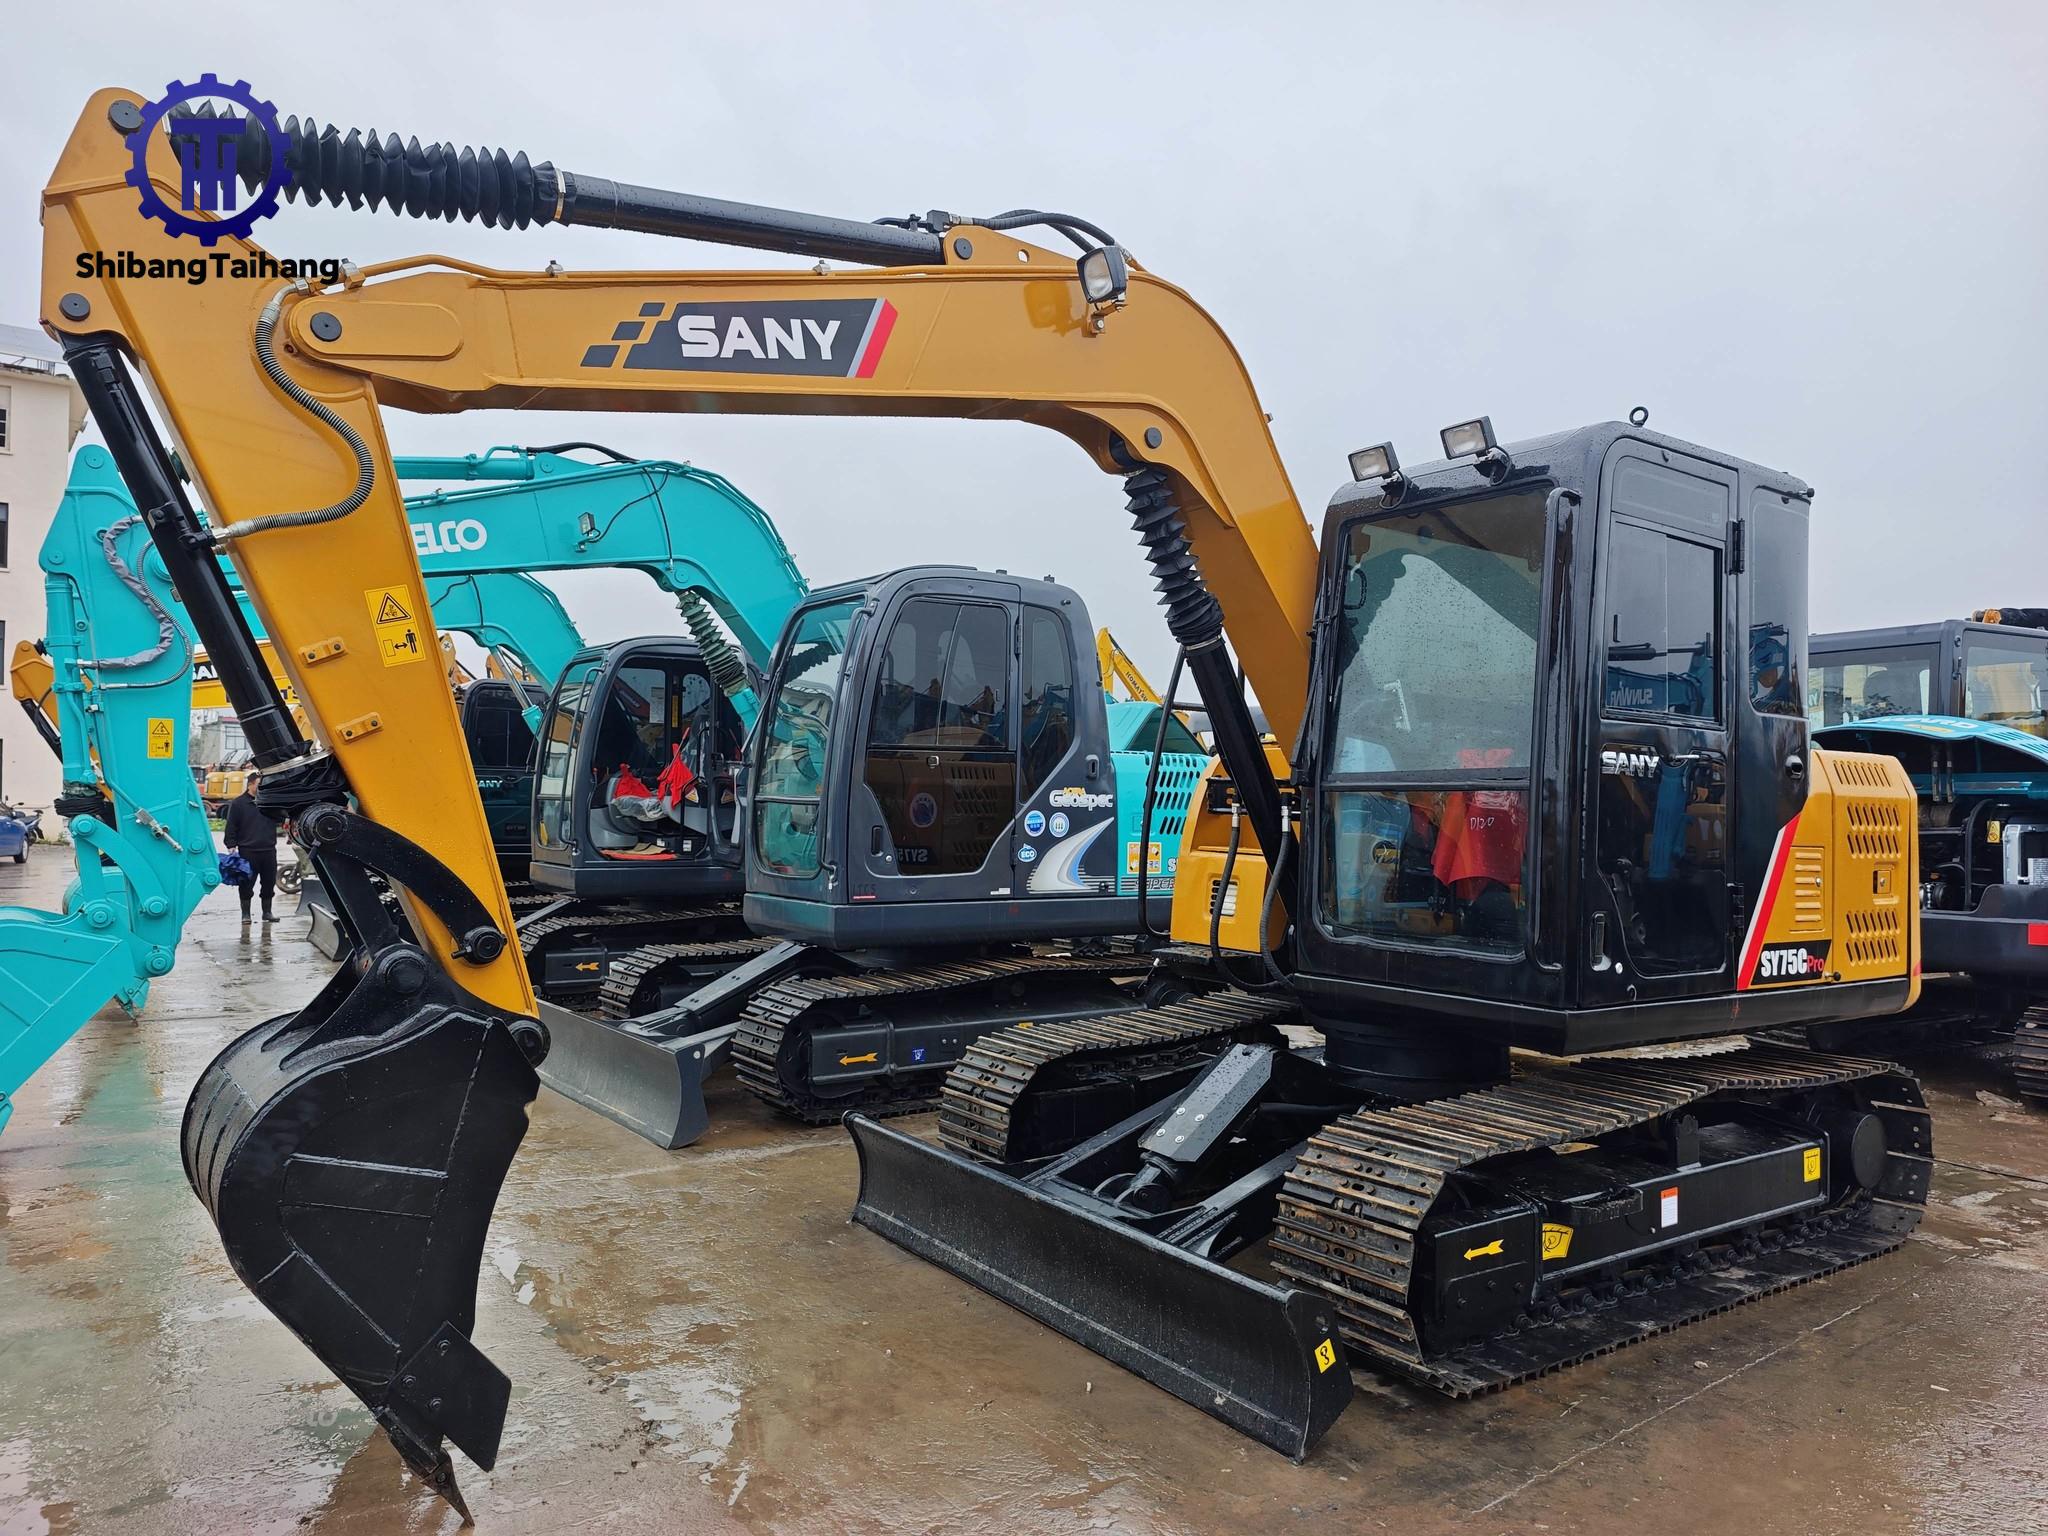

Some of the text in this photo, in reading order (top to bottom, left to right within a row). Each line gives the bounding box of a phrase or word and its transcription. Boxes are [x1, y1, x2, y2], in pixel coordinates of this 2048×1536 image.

[677, 314, 841, 361] SANY
[1601, 751, 1660, 778] SANY
[476, 780, 503, 788] ANY
[1049, 789, 1114, 812] Geospec
[1020, 850, 1035, 859] ECO
